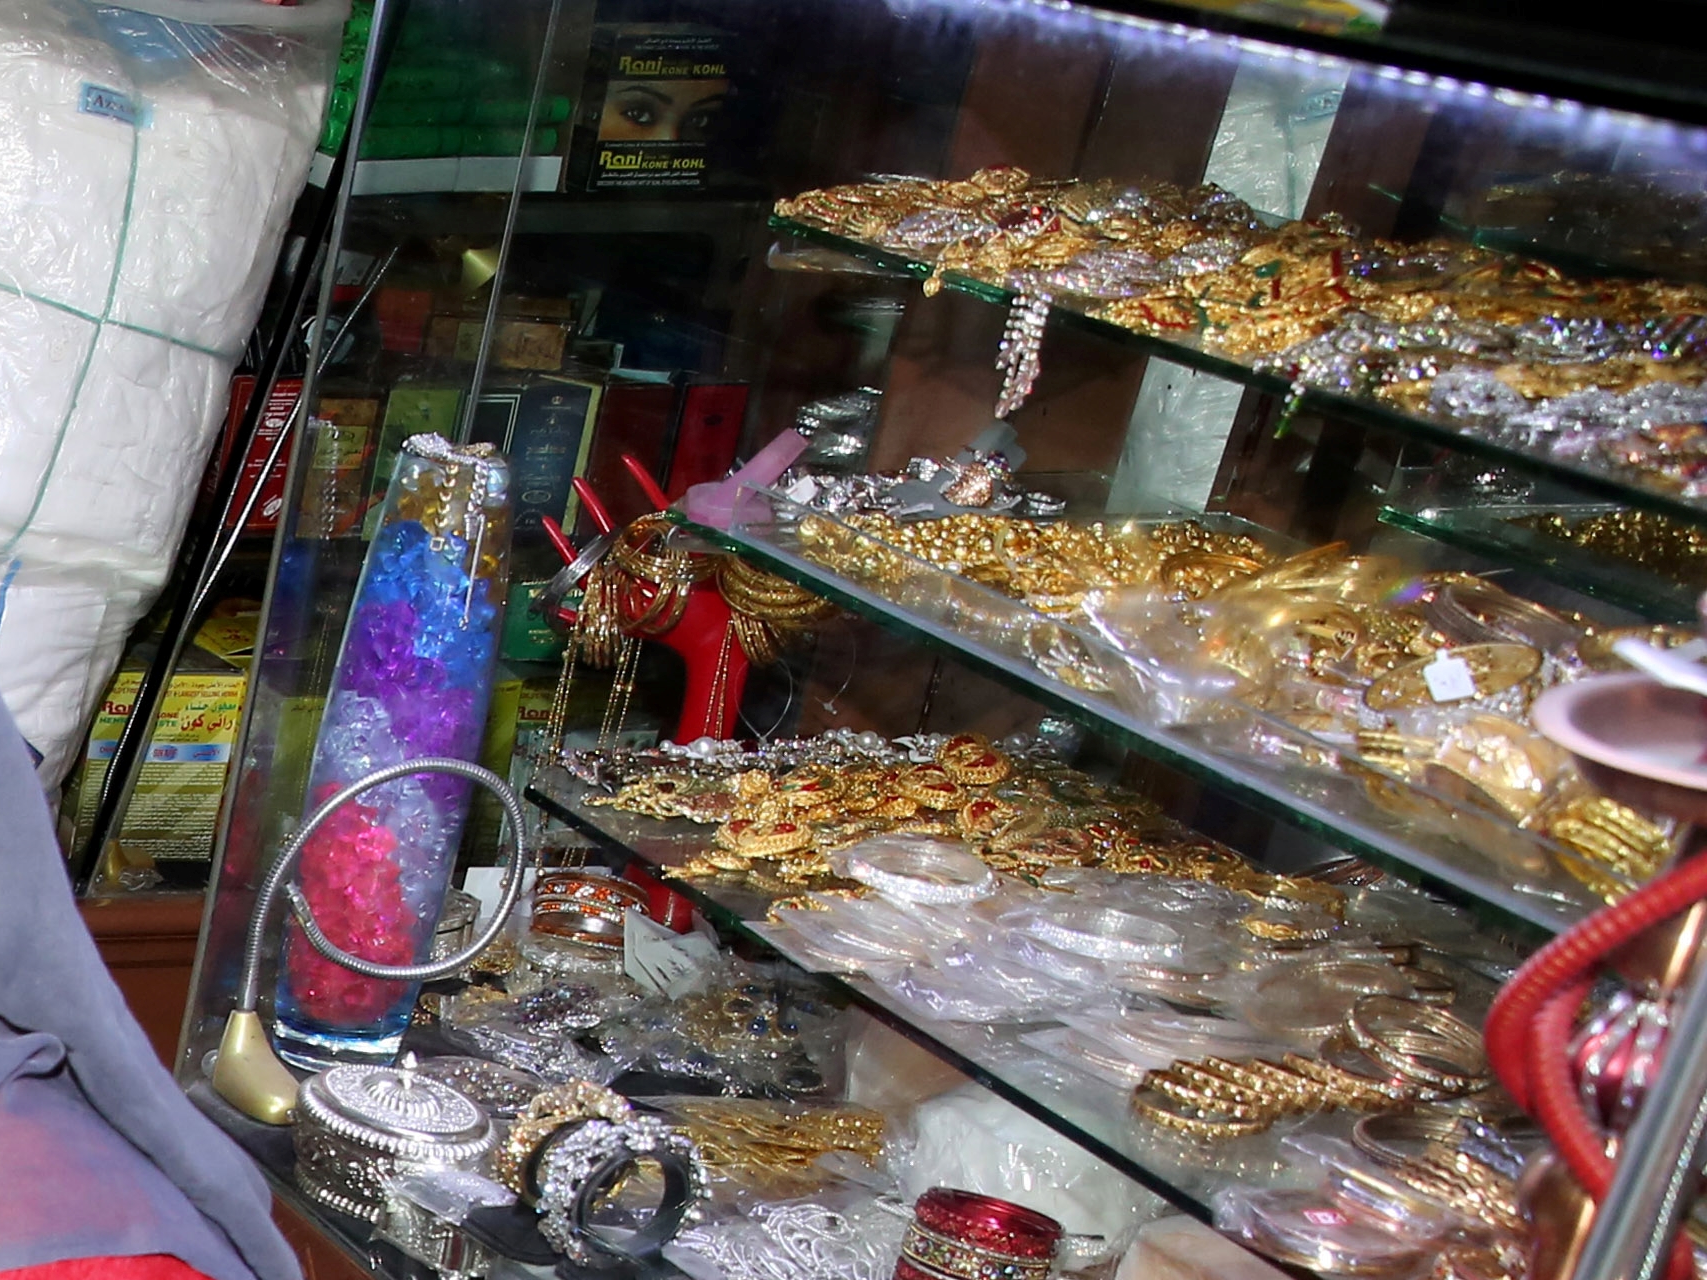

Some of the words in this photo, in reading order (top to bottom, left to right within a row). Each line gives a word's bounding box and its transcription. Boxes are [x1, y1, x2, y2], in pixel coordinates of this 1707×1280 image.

[618, 55, 663, 75] Rani
[692, 64, 728, 75] KOHL
[599, 149, 643, 170] Rani
[672, 158, 707, 169] KOHL
